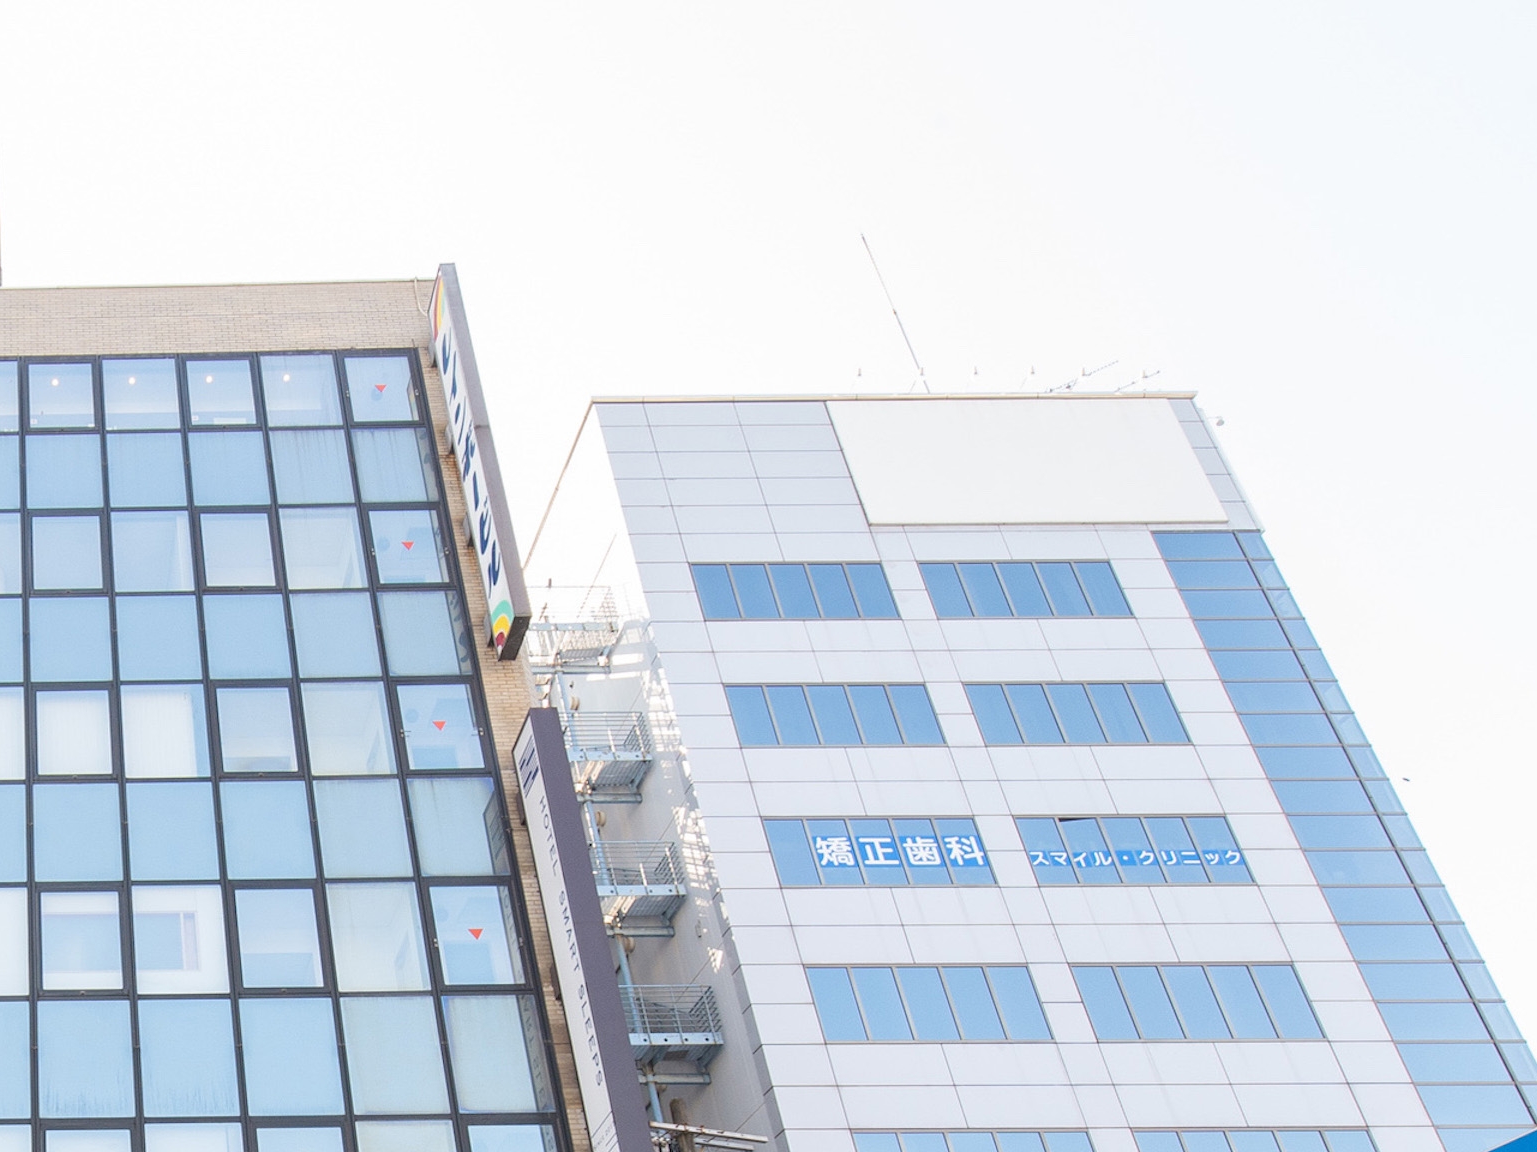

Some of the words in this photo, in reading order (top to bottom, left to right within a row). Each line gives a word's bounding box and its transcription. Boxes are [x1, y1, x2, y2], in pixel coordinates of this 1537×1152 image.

[815, 836, 986, 867] 矯正歯科
[1029, 850, 1242, 867] スマイル・クリニック
[539, 795, 558, 877] HOTEL
[558, 890, 581, 973] SMART
[577, 984, 603, 1087] SLEEPS
